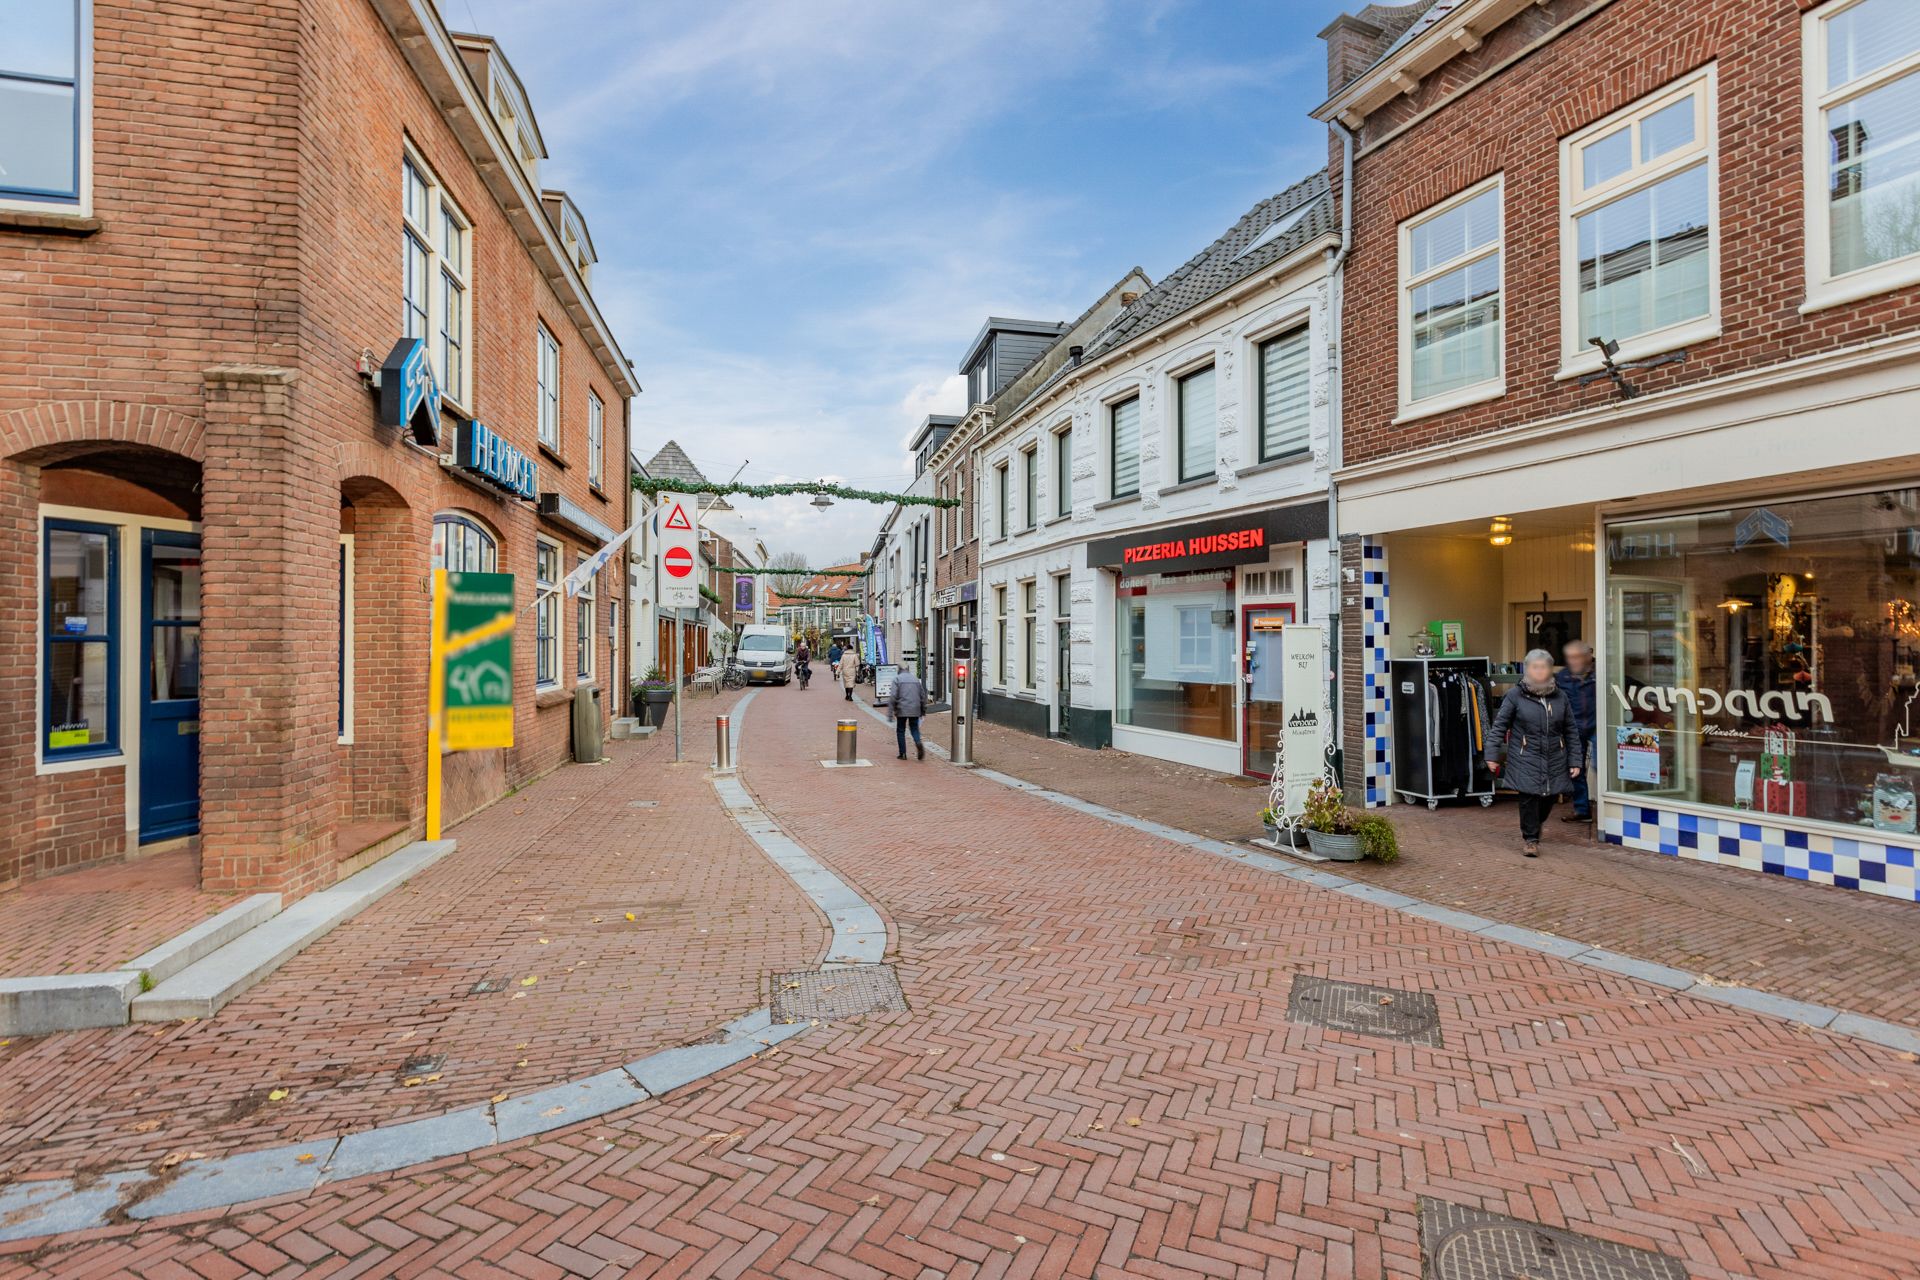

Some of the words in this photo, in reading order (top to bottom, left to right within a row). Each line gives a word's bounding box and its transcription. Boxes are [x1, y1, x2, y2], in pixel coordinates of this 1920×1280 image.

[1124, 541, 1187, 563] PIZZERIA
[1189, 528, 1264, 555] HUISSEN
[1120, 577, 1145, 589] döner
[1151, 575, 1177, 590] pizza
[1185, 570, 1232, 584] shoarma
[1526, 614, 1544, 634] 12
[1699, 724, 1750, 738] Mixstore
